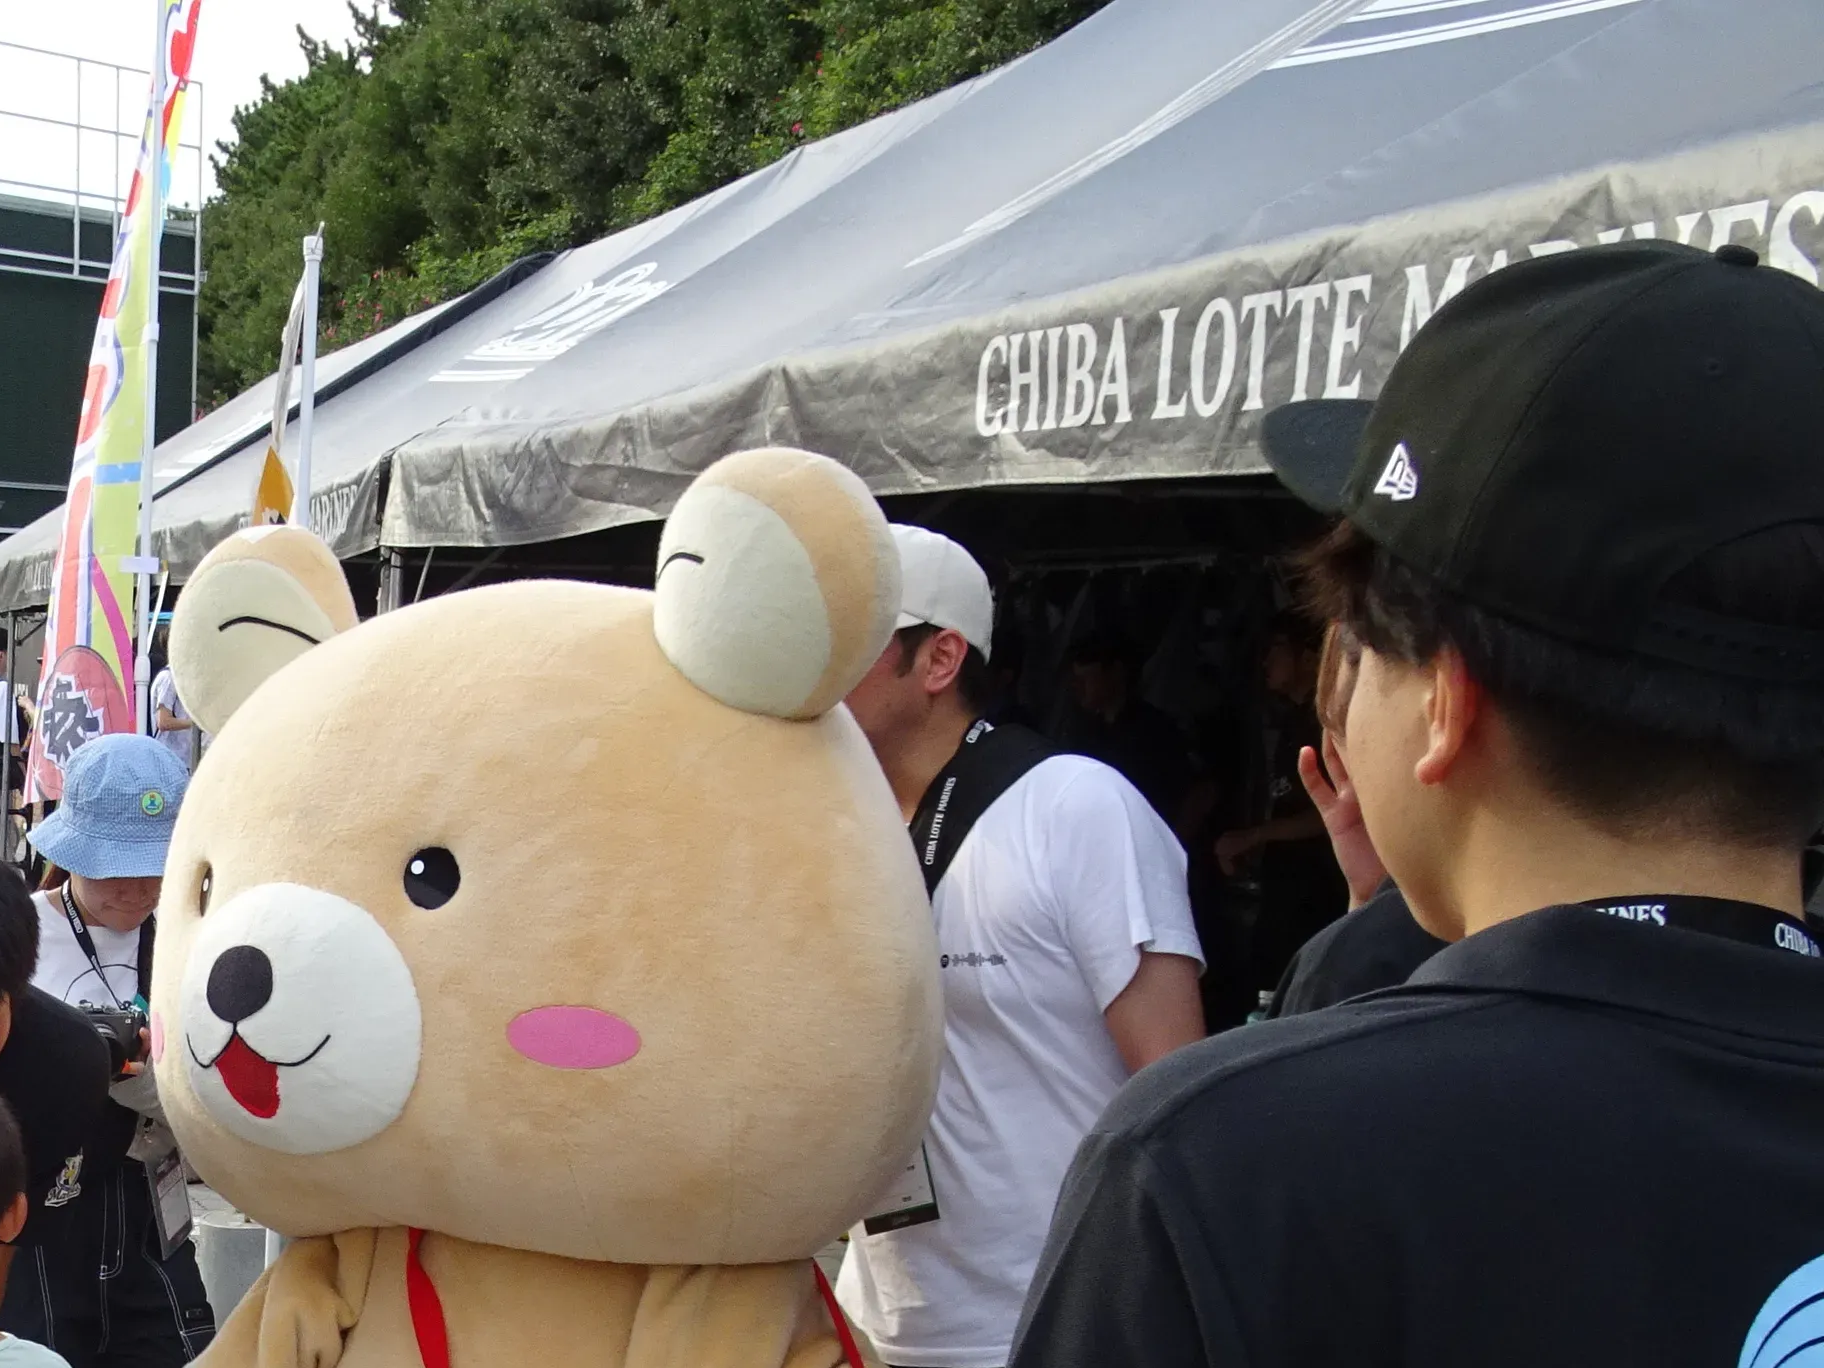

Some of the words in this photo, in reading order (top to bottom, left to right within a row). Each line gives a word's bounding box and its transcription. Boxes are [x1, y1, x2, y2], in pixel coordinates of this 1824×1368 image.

[975, 323, 1131, 437] CHIBA
[1149, 275, 1371, 421] LOTTE
[930, 811, 945, 839] LOTTE
[938, 776, 957, 811] MARINES
